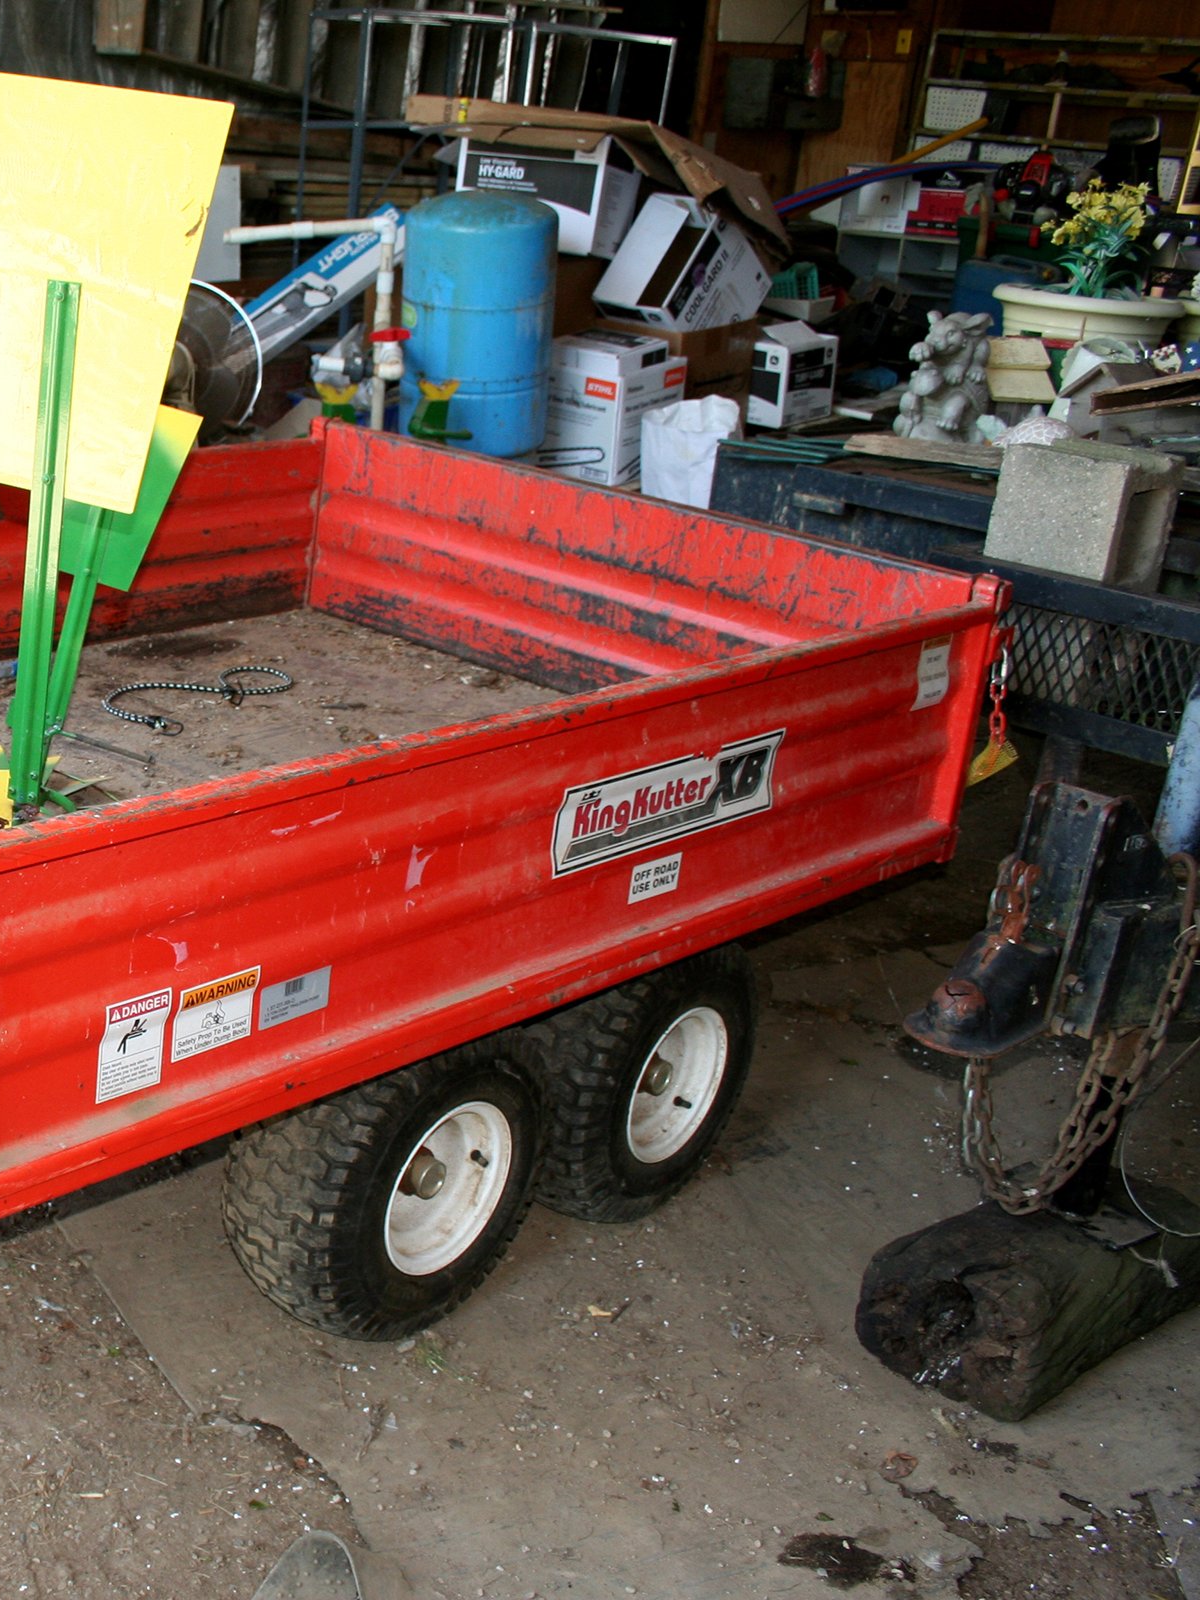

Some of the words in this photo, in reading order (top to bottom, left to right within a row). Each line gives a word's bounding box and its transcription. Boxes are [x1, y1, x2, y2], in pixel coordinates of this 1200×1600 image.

[586, 382, 615, 396] STIHL
[632, 882, 650, 895] USE
[652, 872, 678, 889] ONLY
[633, 868, 652, 883] OFF
[653, 860, 679, 877] ROAD
[195, 974, 256, 1006] WARNING
[121, 994, 169, 1018] DANGER
[175, 1045, 193, 1057] When
[194, 1038, 213, 1050] Under
[213, 1032, 232, 1044] Dump
[232, 1027, 248, 1037] Body
[177, 1036, 197, 1049] Safety
[198, 1030, 213, 1042] Prop
[213, 1027, 222, 1035] To
[222, 1023, 231, 1033] Be
[231, 1018, 247, 1029] Used
